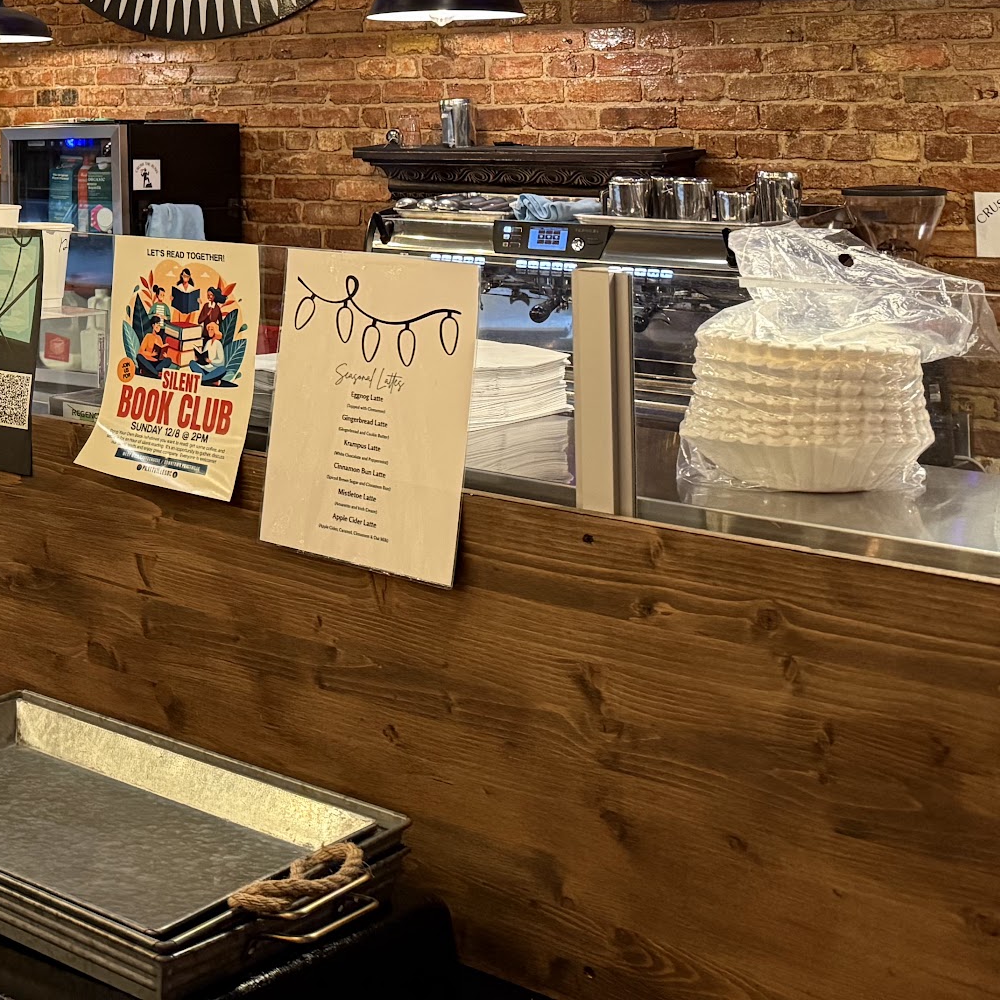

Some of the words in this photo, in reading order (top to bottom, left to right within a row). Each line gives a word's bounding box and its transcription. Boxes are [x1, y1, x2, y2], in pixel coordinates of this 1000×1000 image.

[977, 199, 1000, 223] CRUS
[147, 249, 165, 257] LET'S
[166, 250, 185, 259] READ
[187, 251, 225, 262] TOGETHER!
[163, 371, 200, 393] SILENT
[335, 363, 376, 388] Seasonal
[377, 368, 404, 394] Lattes
[351, 391, 369, 401] Eggnog
[117, 385, 174, 425] BOOK
[178, 394, 233, 435] CLUB
[342, 414, 373, 426] Gingerbread
[375, 420, 387, 428] Latte
[131, 422, 163, 434] SUNDAY
[165, 427, 180, 438] 12/8
[182, 431, 189, 440] @
[191, 432, 208, 443] 2PM
[344, 440, 366, 449] Krampus
[368, 444, 381, 452] Latte
[334, 462, 360, 473] Cinnamon
[373, 470, 386, 478] Latte
[338, 489, 362, 499] Mistletoe
[363, 494, 376, 502] Latte
[332, 513, 348, 521] Apple
[349, 516, 362, 524] Cider
[363, 519, 376, 528] Latte
